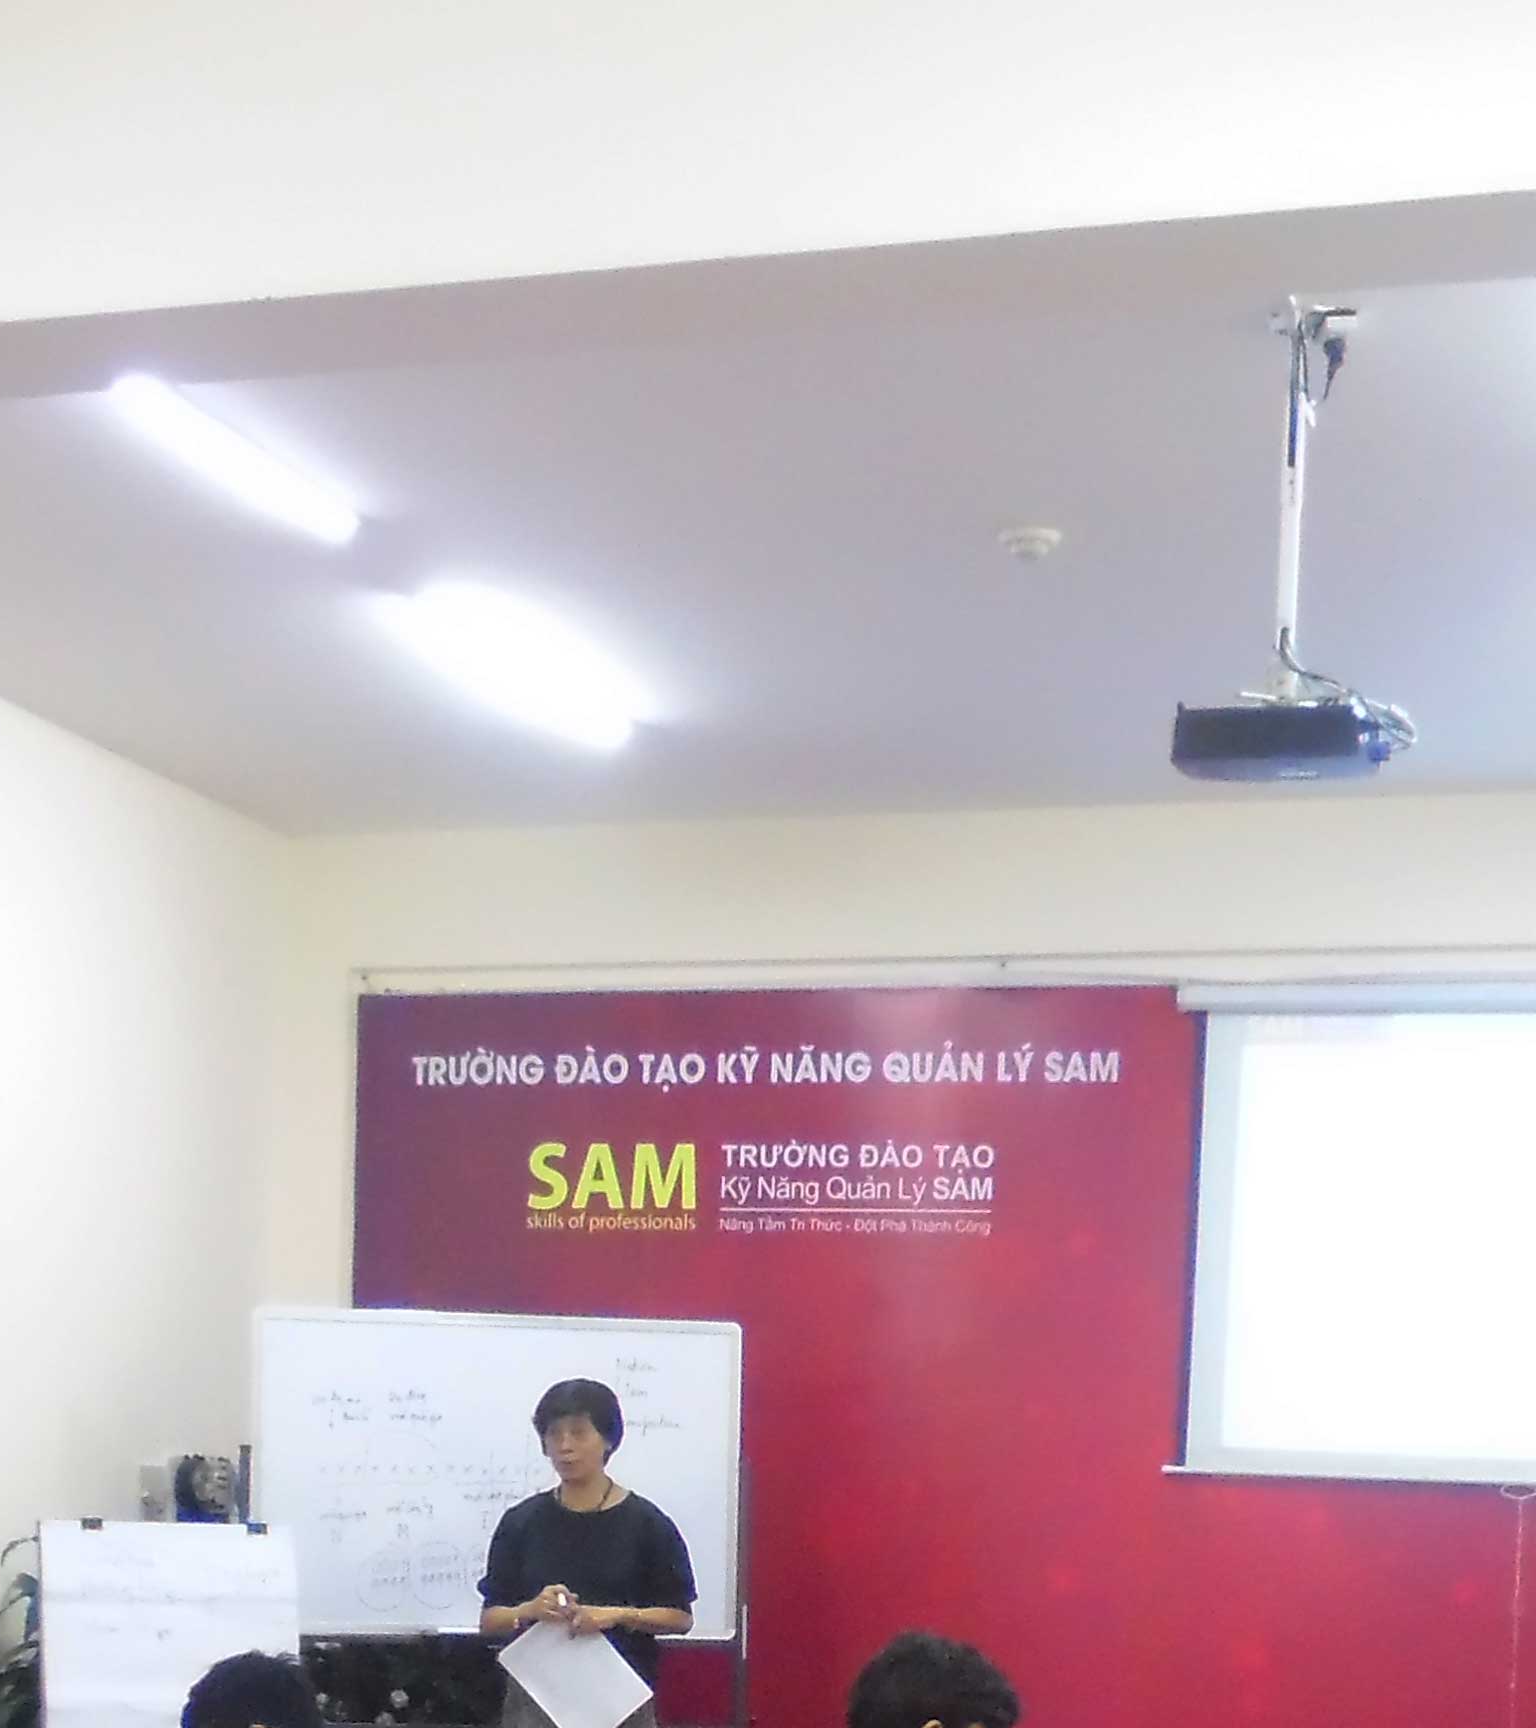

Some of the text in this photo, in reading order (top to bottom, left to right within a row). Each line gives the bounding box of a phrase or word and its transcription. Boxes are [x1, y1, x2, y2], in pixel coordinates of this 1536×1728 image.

[412, 1040, 1120, 1093] TRƯỜNG ĐÀO TẠO KỸ NĂNG QUẢN LÝ SAM
[721, 1139, 995, 1175] TRƯỜNG ĐÀO TẠO
[527, 1142, 697, 1210] SAM
[720, 1175, 994, 1205] Kỹ Năng Quản Lý SAM
[526, 1212, 697, 1232] skills of professionals
